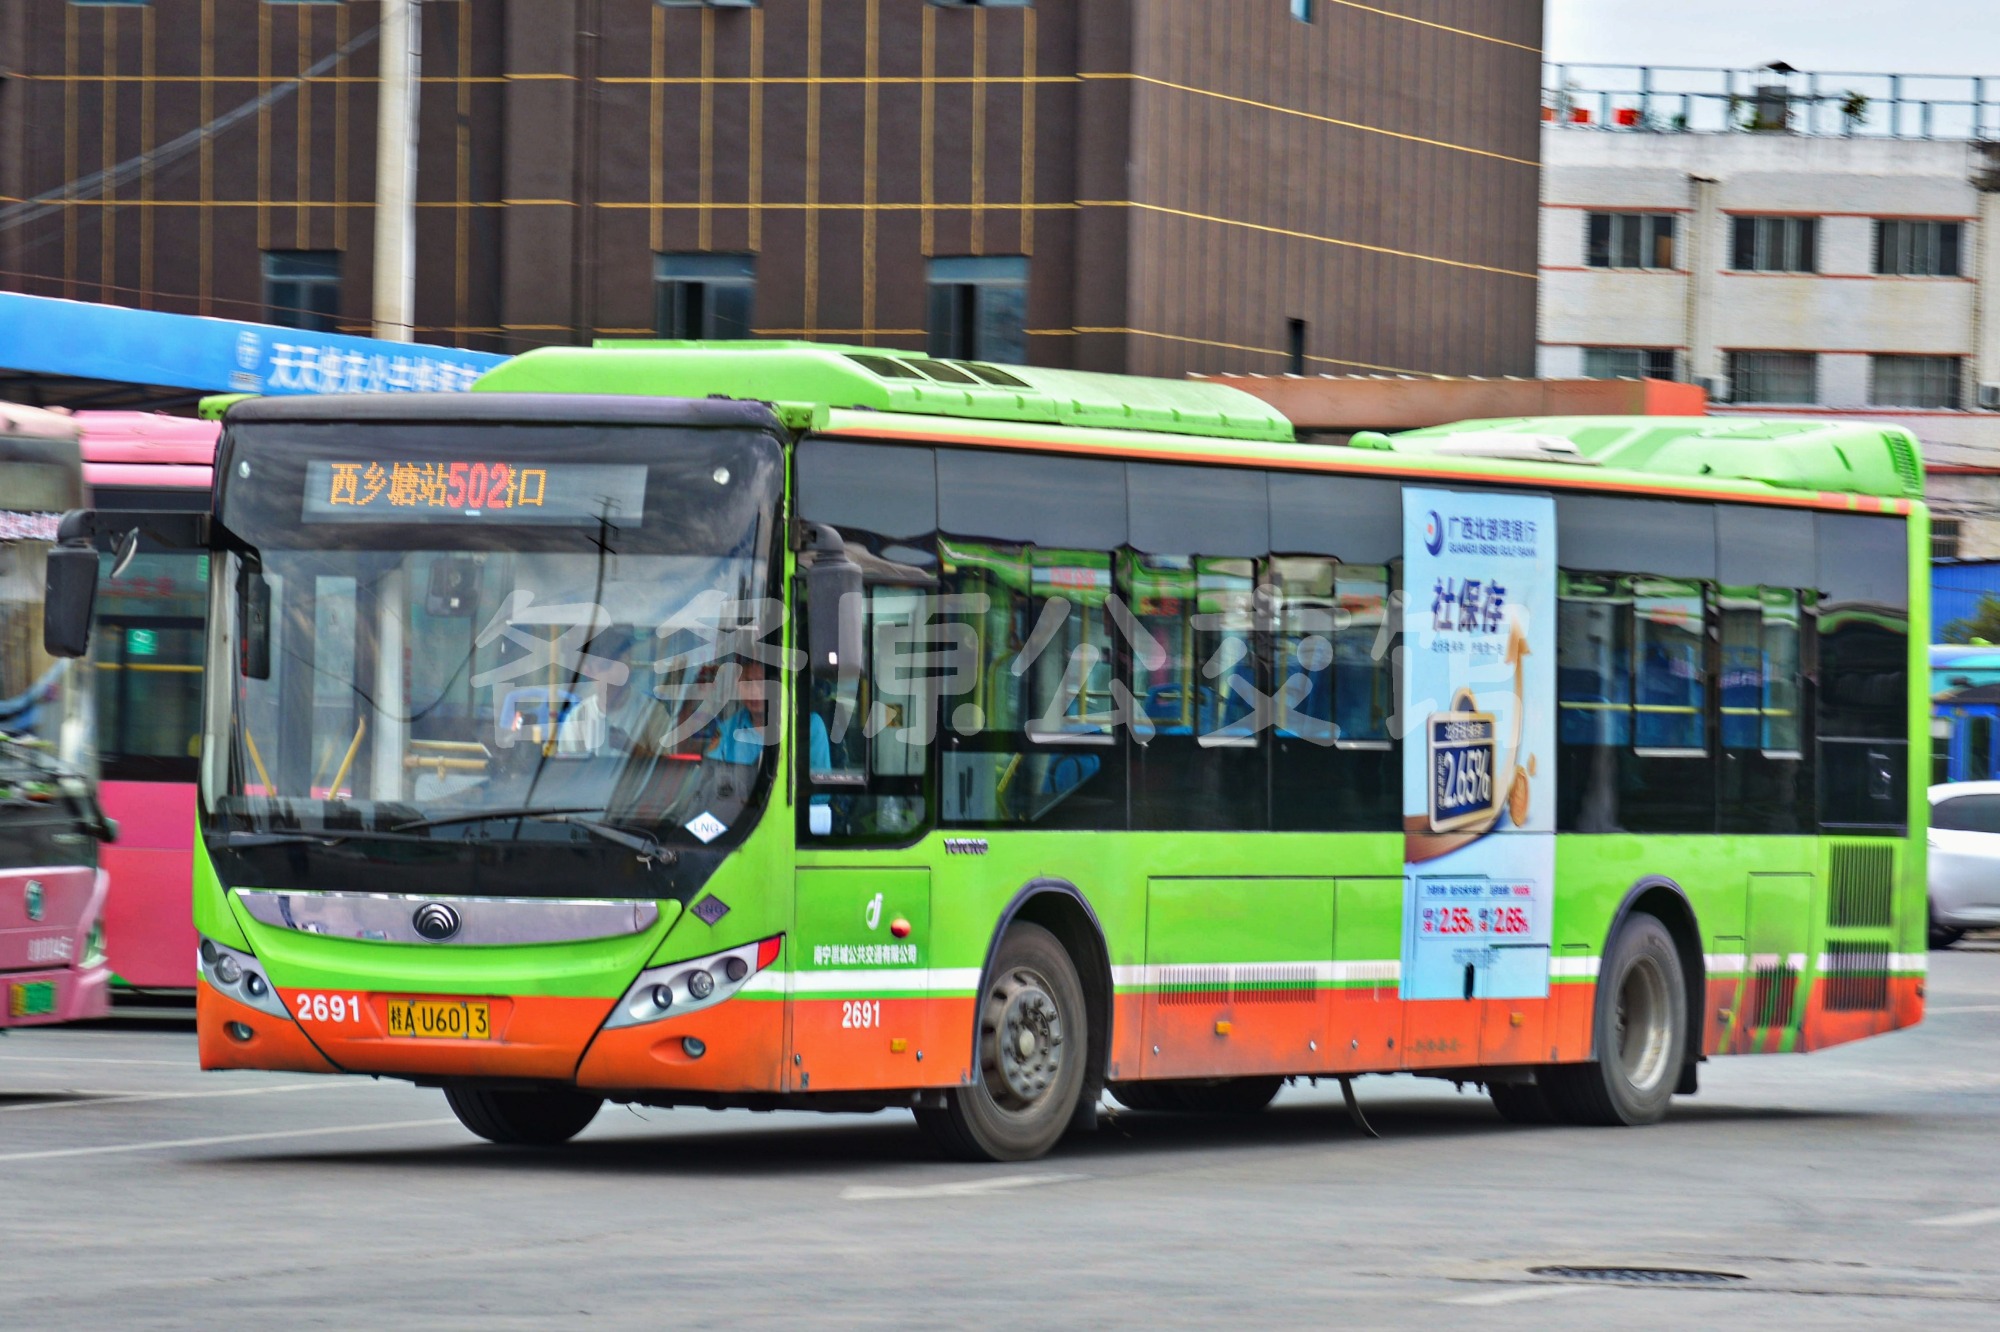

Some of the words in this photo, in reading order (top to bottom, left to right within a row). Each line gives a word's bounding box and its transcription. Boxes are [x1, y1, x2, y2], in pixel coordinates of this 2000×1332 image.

[693, 822, 721, 834] LNG
[296, 993, 361, 1023] 2691
[841, 1000, 881, 1029] 2691
